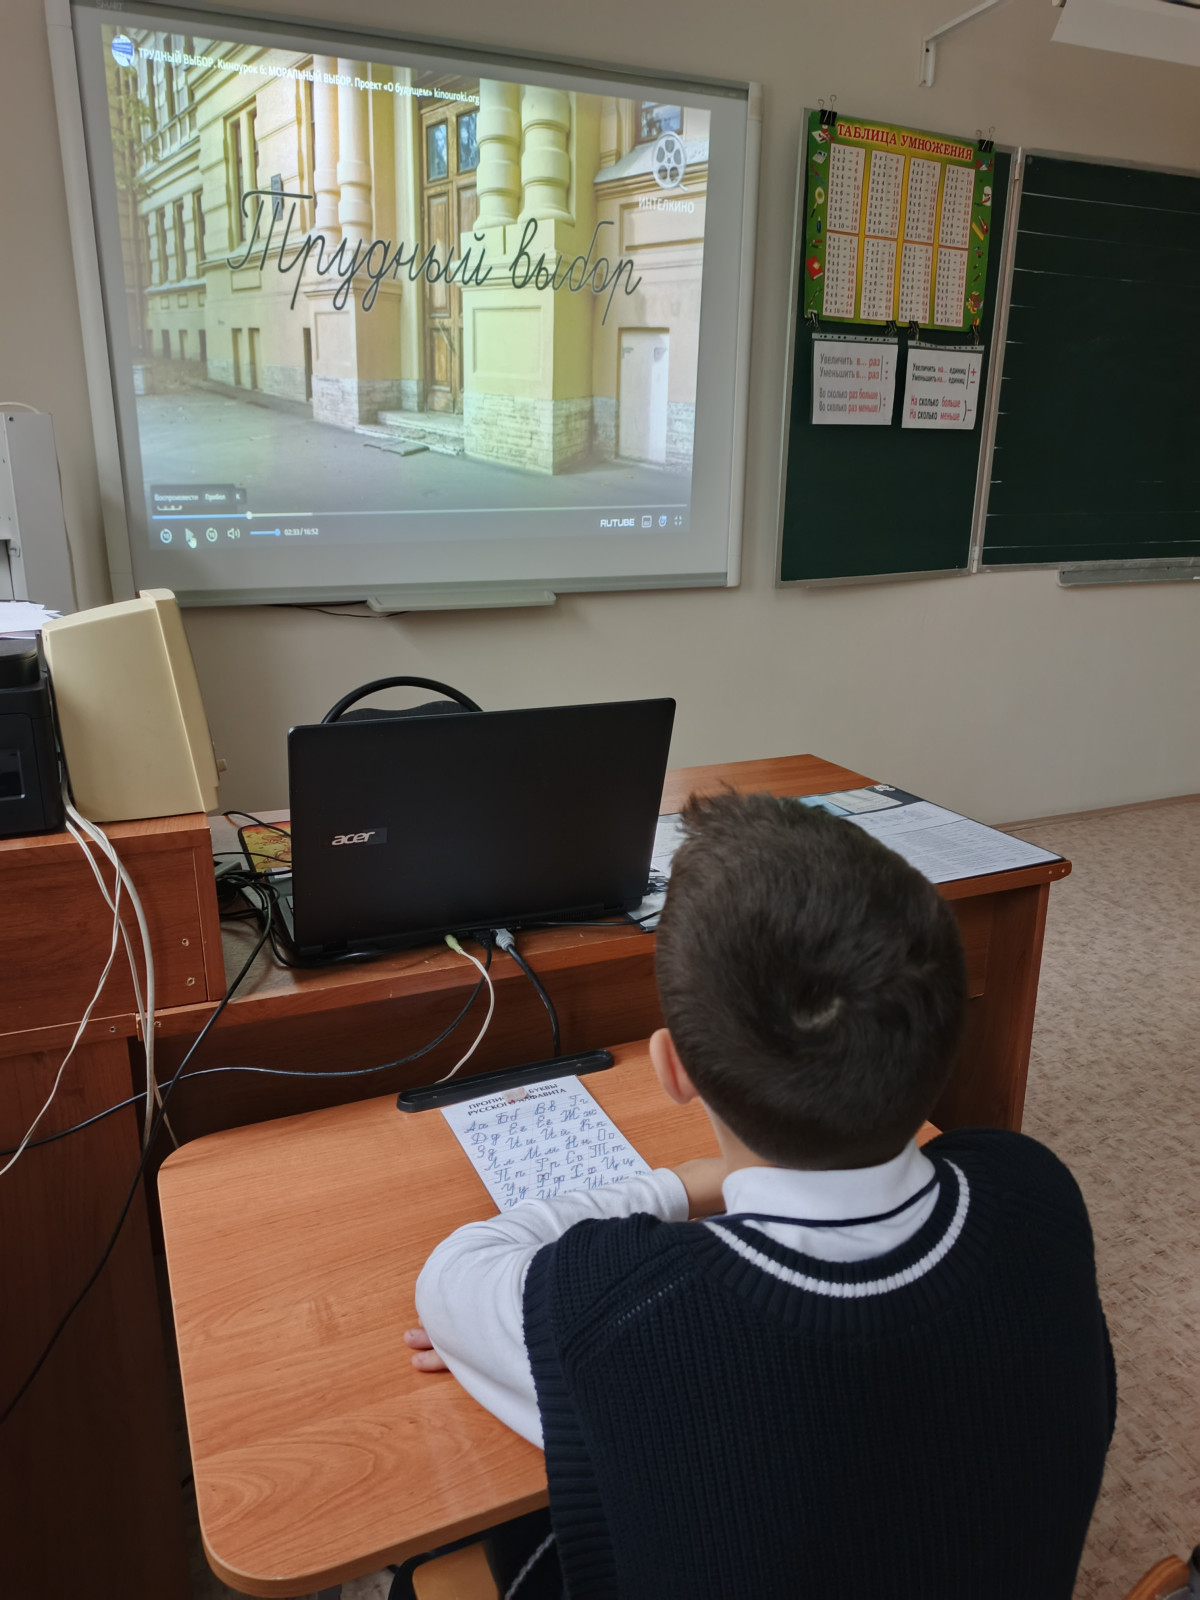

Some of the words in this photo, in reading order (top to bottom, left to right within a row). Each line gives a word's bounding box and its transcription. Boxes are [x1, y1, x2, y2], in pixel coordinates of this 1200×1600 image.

[138, 47, 182, 63] ТРУДНЫЙ
[268, 65, 323, 82] МОРАЛЬНЫЙ
[354, 77, 382, 91] Проект
[433, 88, 480, 106] kinouroki.org
[837, 124, 897, 147] ТАБЛИЦА
[900, 135, 974, 161] УМНОЖЕНИЯ
[638, 197, 695, 214] ИНТЕЛКИНО
[226, 190, 493, 312] Трудный
[508, 217, 643, 327] выбор
[820, 353, 853, 365] Увеличить
[868, 358, 880, 368] раз
[819, 367, 855, 379] Уменьшить
[867, 371, 879, 381] раз
[912, 363, 936, 373] Увеличить
[911, 373, 936, 383] Уменьшить
[819, 388, 826, 398] Во
[827, 390, 847, 399] сколько
[848, 390, 858, 401] раз
[859, 388, 878, 399] больше
[819, 401, 826, 411] Во
[827, 403, 847, 412] сколько
[848, 403, 858, 413] раз
[858, 403, 878, 413] меньше
[910, 395, 917, 406] На
[918, 397, 939, 407] сколько
[941, 396, 961, 408] больше
[909, 410, 916, 420] На
[917, 411, 938, 420] сколько
[940, 413, 960, 422] меньше
[600, 518, 635, 528] RUTUBE
[331, 831, 376, 846] acer
[528, 1083, 557, 1094] БУКВЫ
